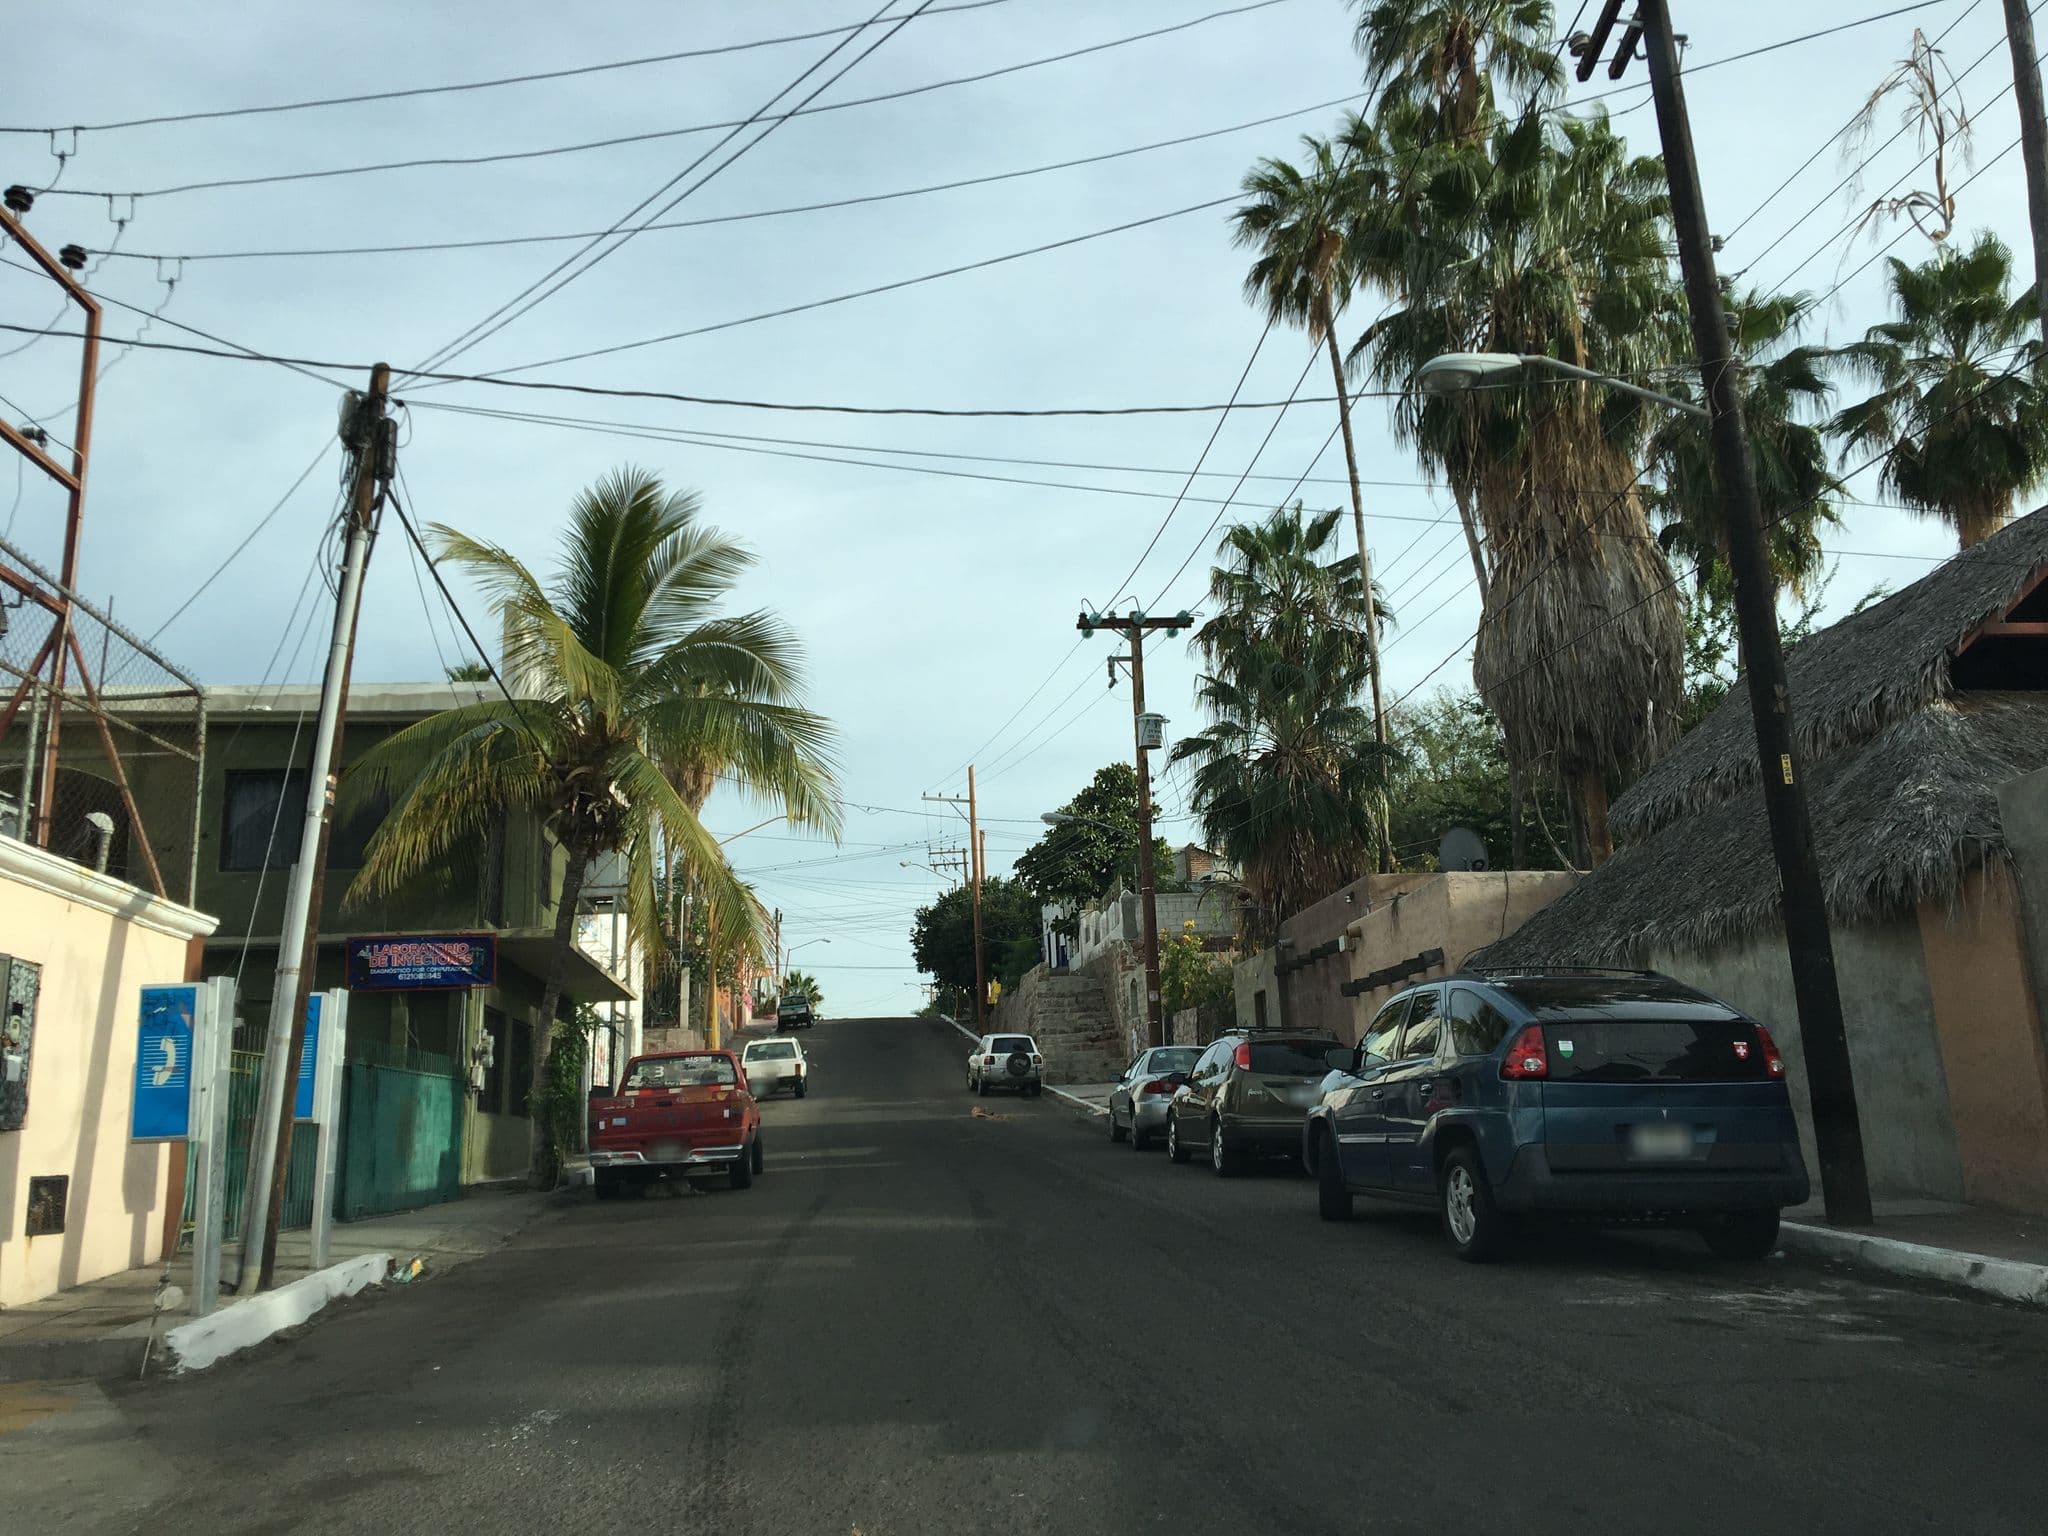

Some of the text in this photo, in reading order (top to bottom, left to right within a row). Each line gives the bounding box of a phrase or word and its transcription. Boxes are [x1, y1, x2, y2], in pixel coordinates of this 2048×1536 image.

[373, 943, 470, 956] LABORATORIO
[369, 954, 473, 968] DE INYECTORES
